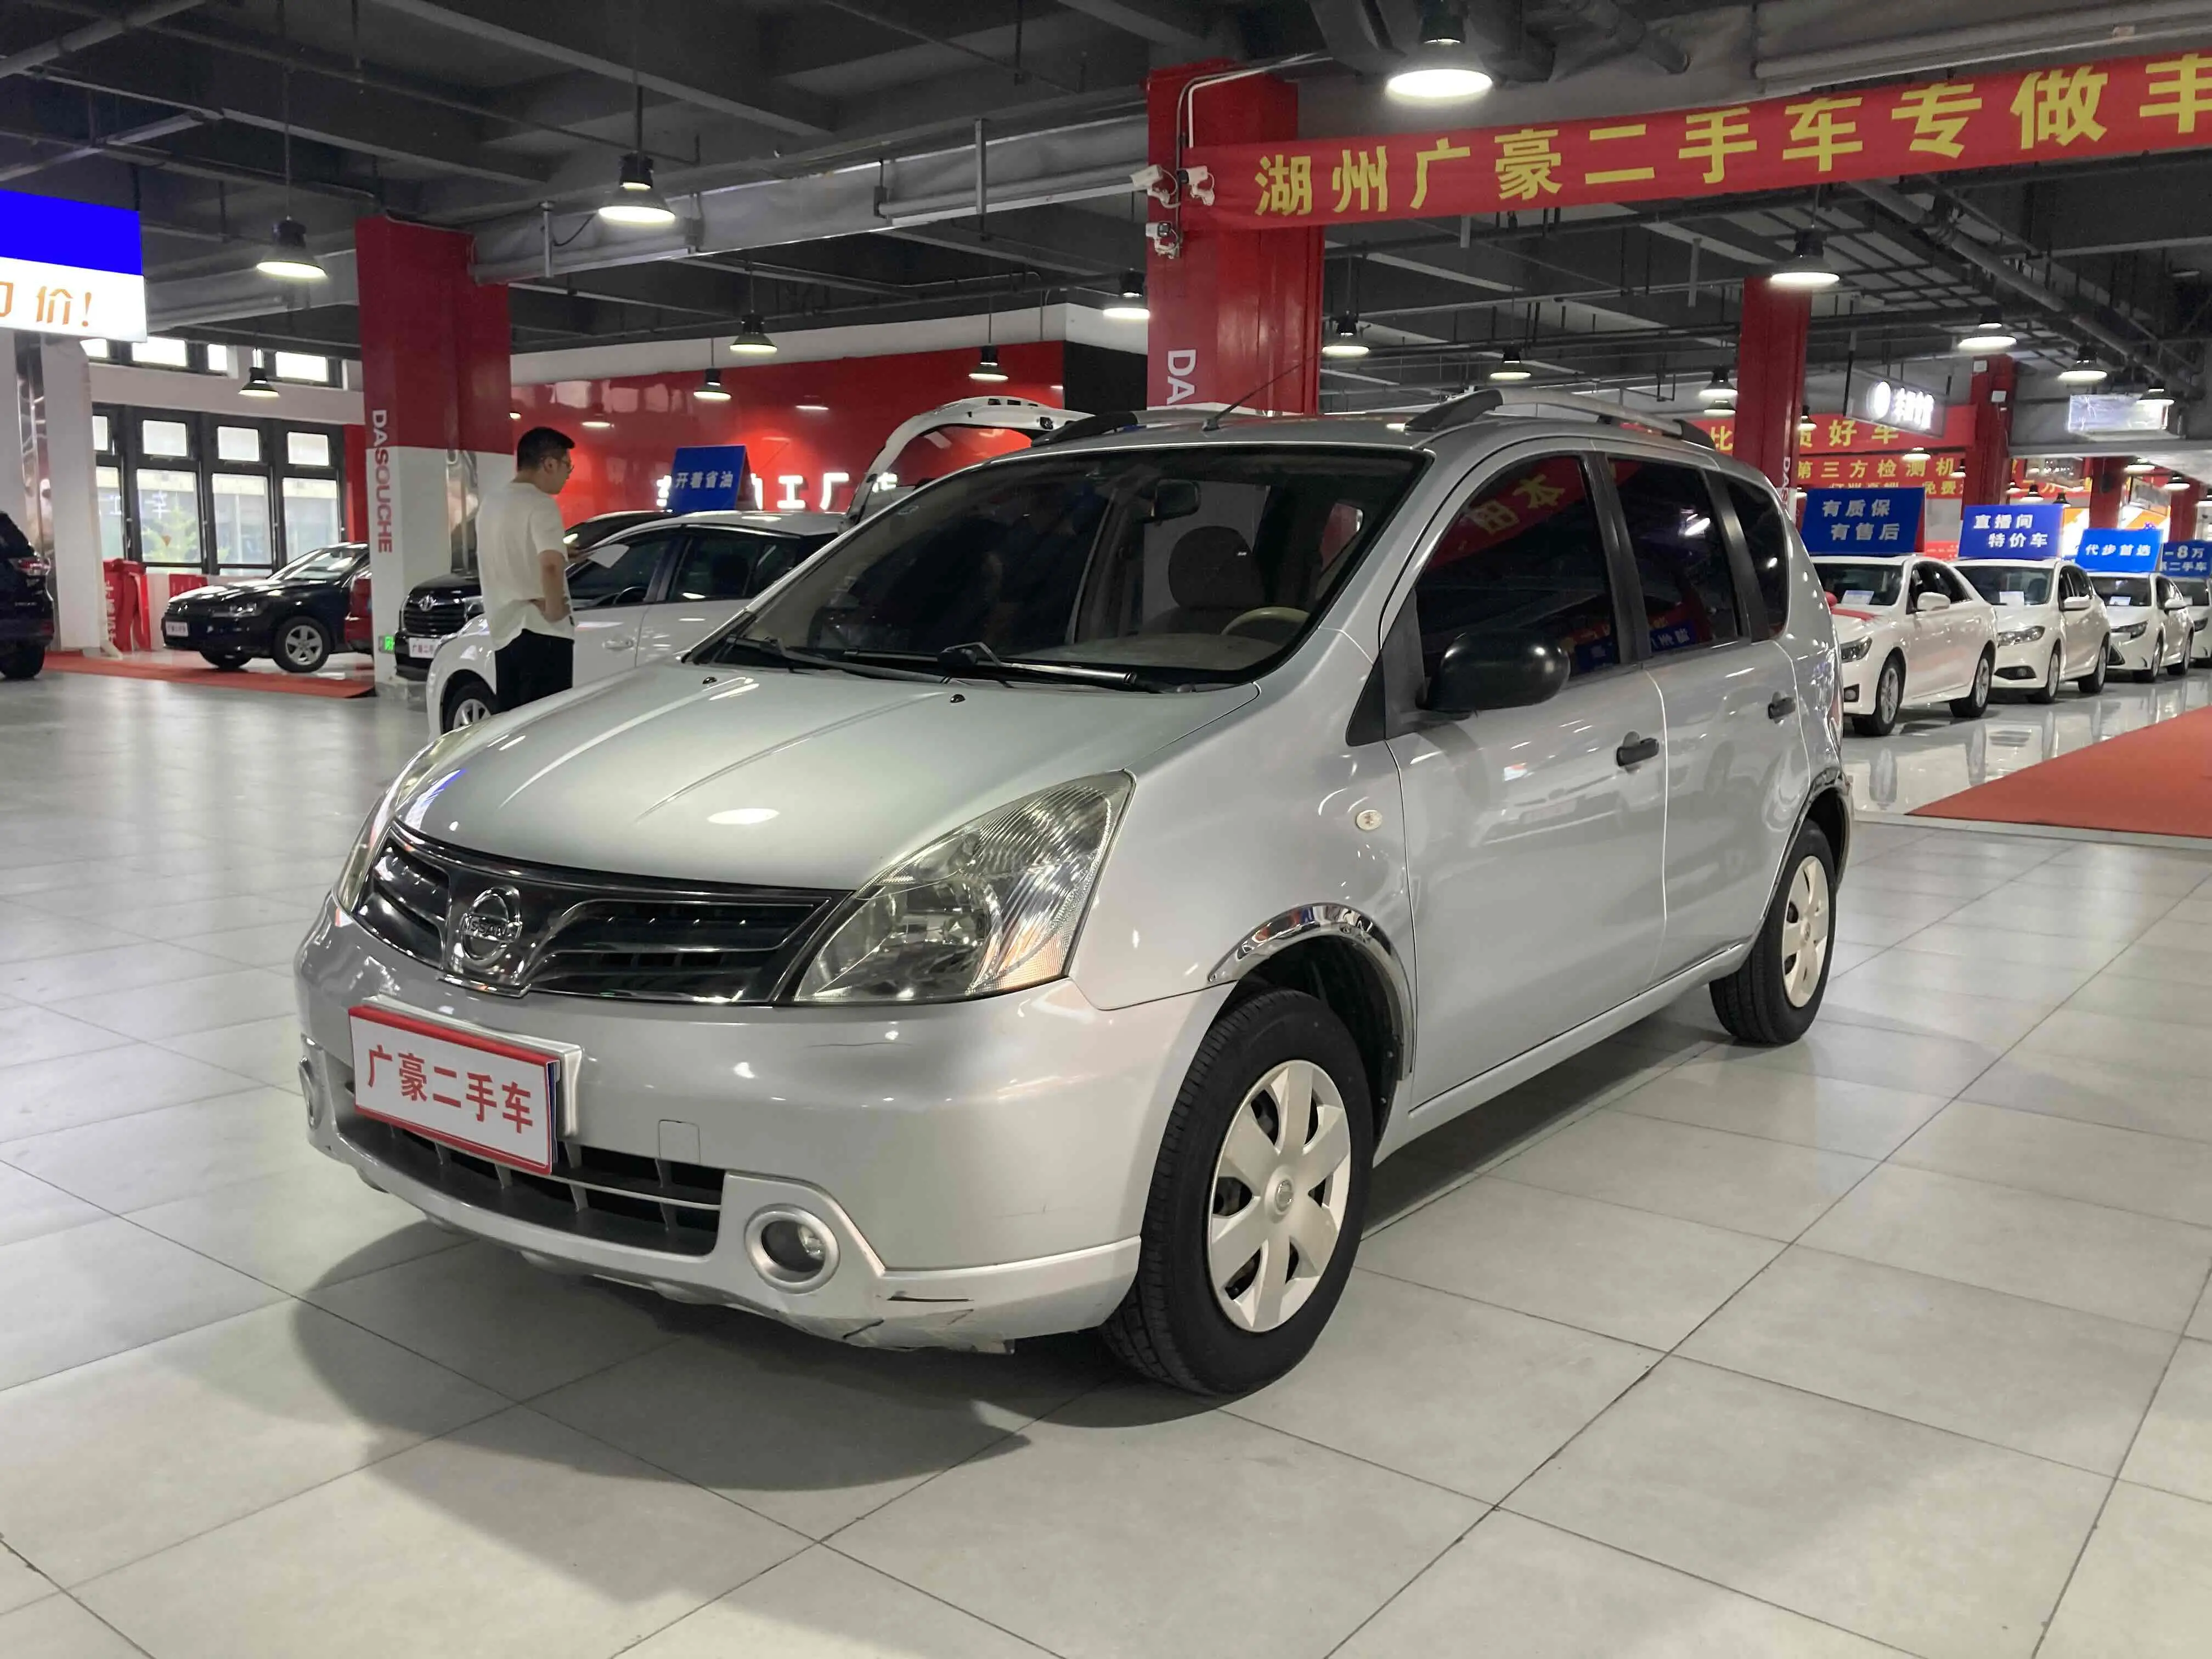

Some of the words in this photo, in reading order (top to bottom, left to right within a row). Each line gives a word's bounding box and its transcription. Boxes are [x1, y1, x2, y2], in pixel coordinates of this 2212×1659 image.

[1255, 53, 2212, 215] 湖州广豪二手车专做丰
[372, 409, 393, 554] DASOUCHE
[676, 471, 733, 489] 开着省油
[1822, 499, 1891, 518] 有质保
[1973, 514, 2034, 530] 直播间
[1831, 523, 1900, 541] 有售后
[1988, 532, 2049, 549] 特价车
[2085, 544, 2152, 557] 代步首选
[368, 1045, 534, 1134] 广豪二手车
